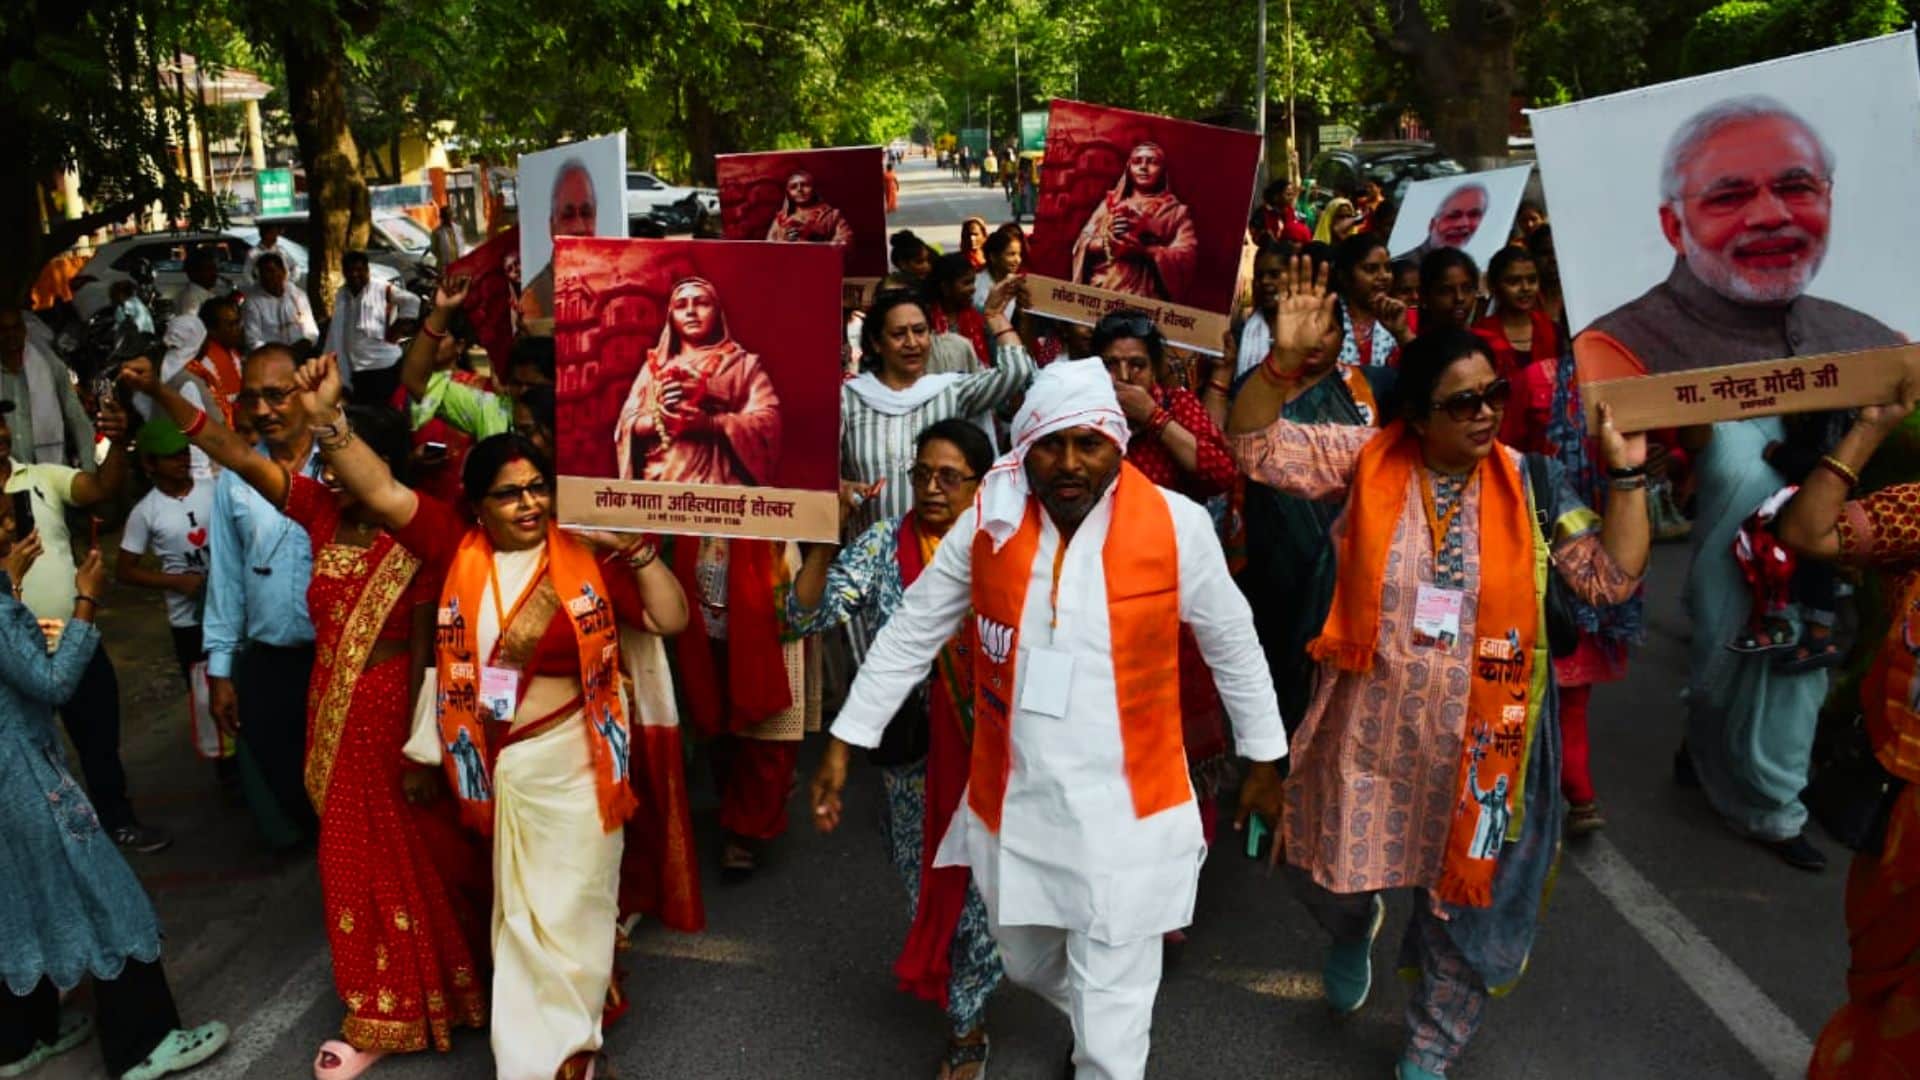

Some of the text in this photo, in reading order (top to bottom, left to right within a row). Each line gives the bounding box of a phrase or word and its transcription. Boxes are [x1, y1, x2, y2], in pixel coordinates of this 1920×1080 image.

[1675, 363, 1839, 403] मा. नरेन्द्र मोदी जी
[594, 486, 628, 508] लोक
[630, 493, 662, 510] माता
[751, 495, 795, 519] होल्कर
[186, 511, 198, 528] I
